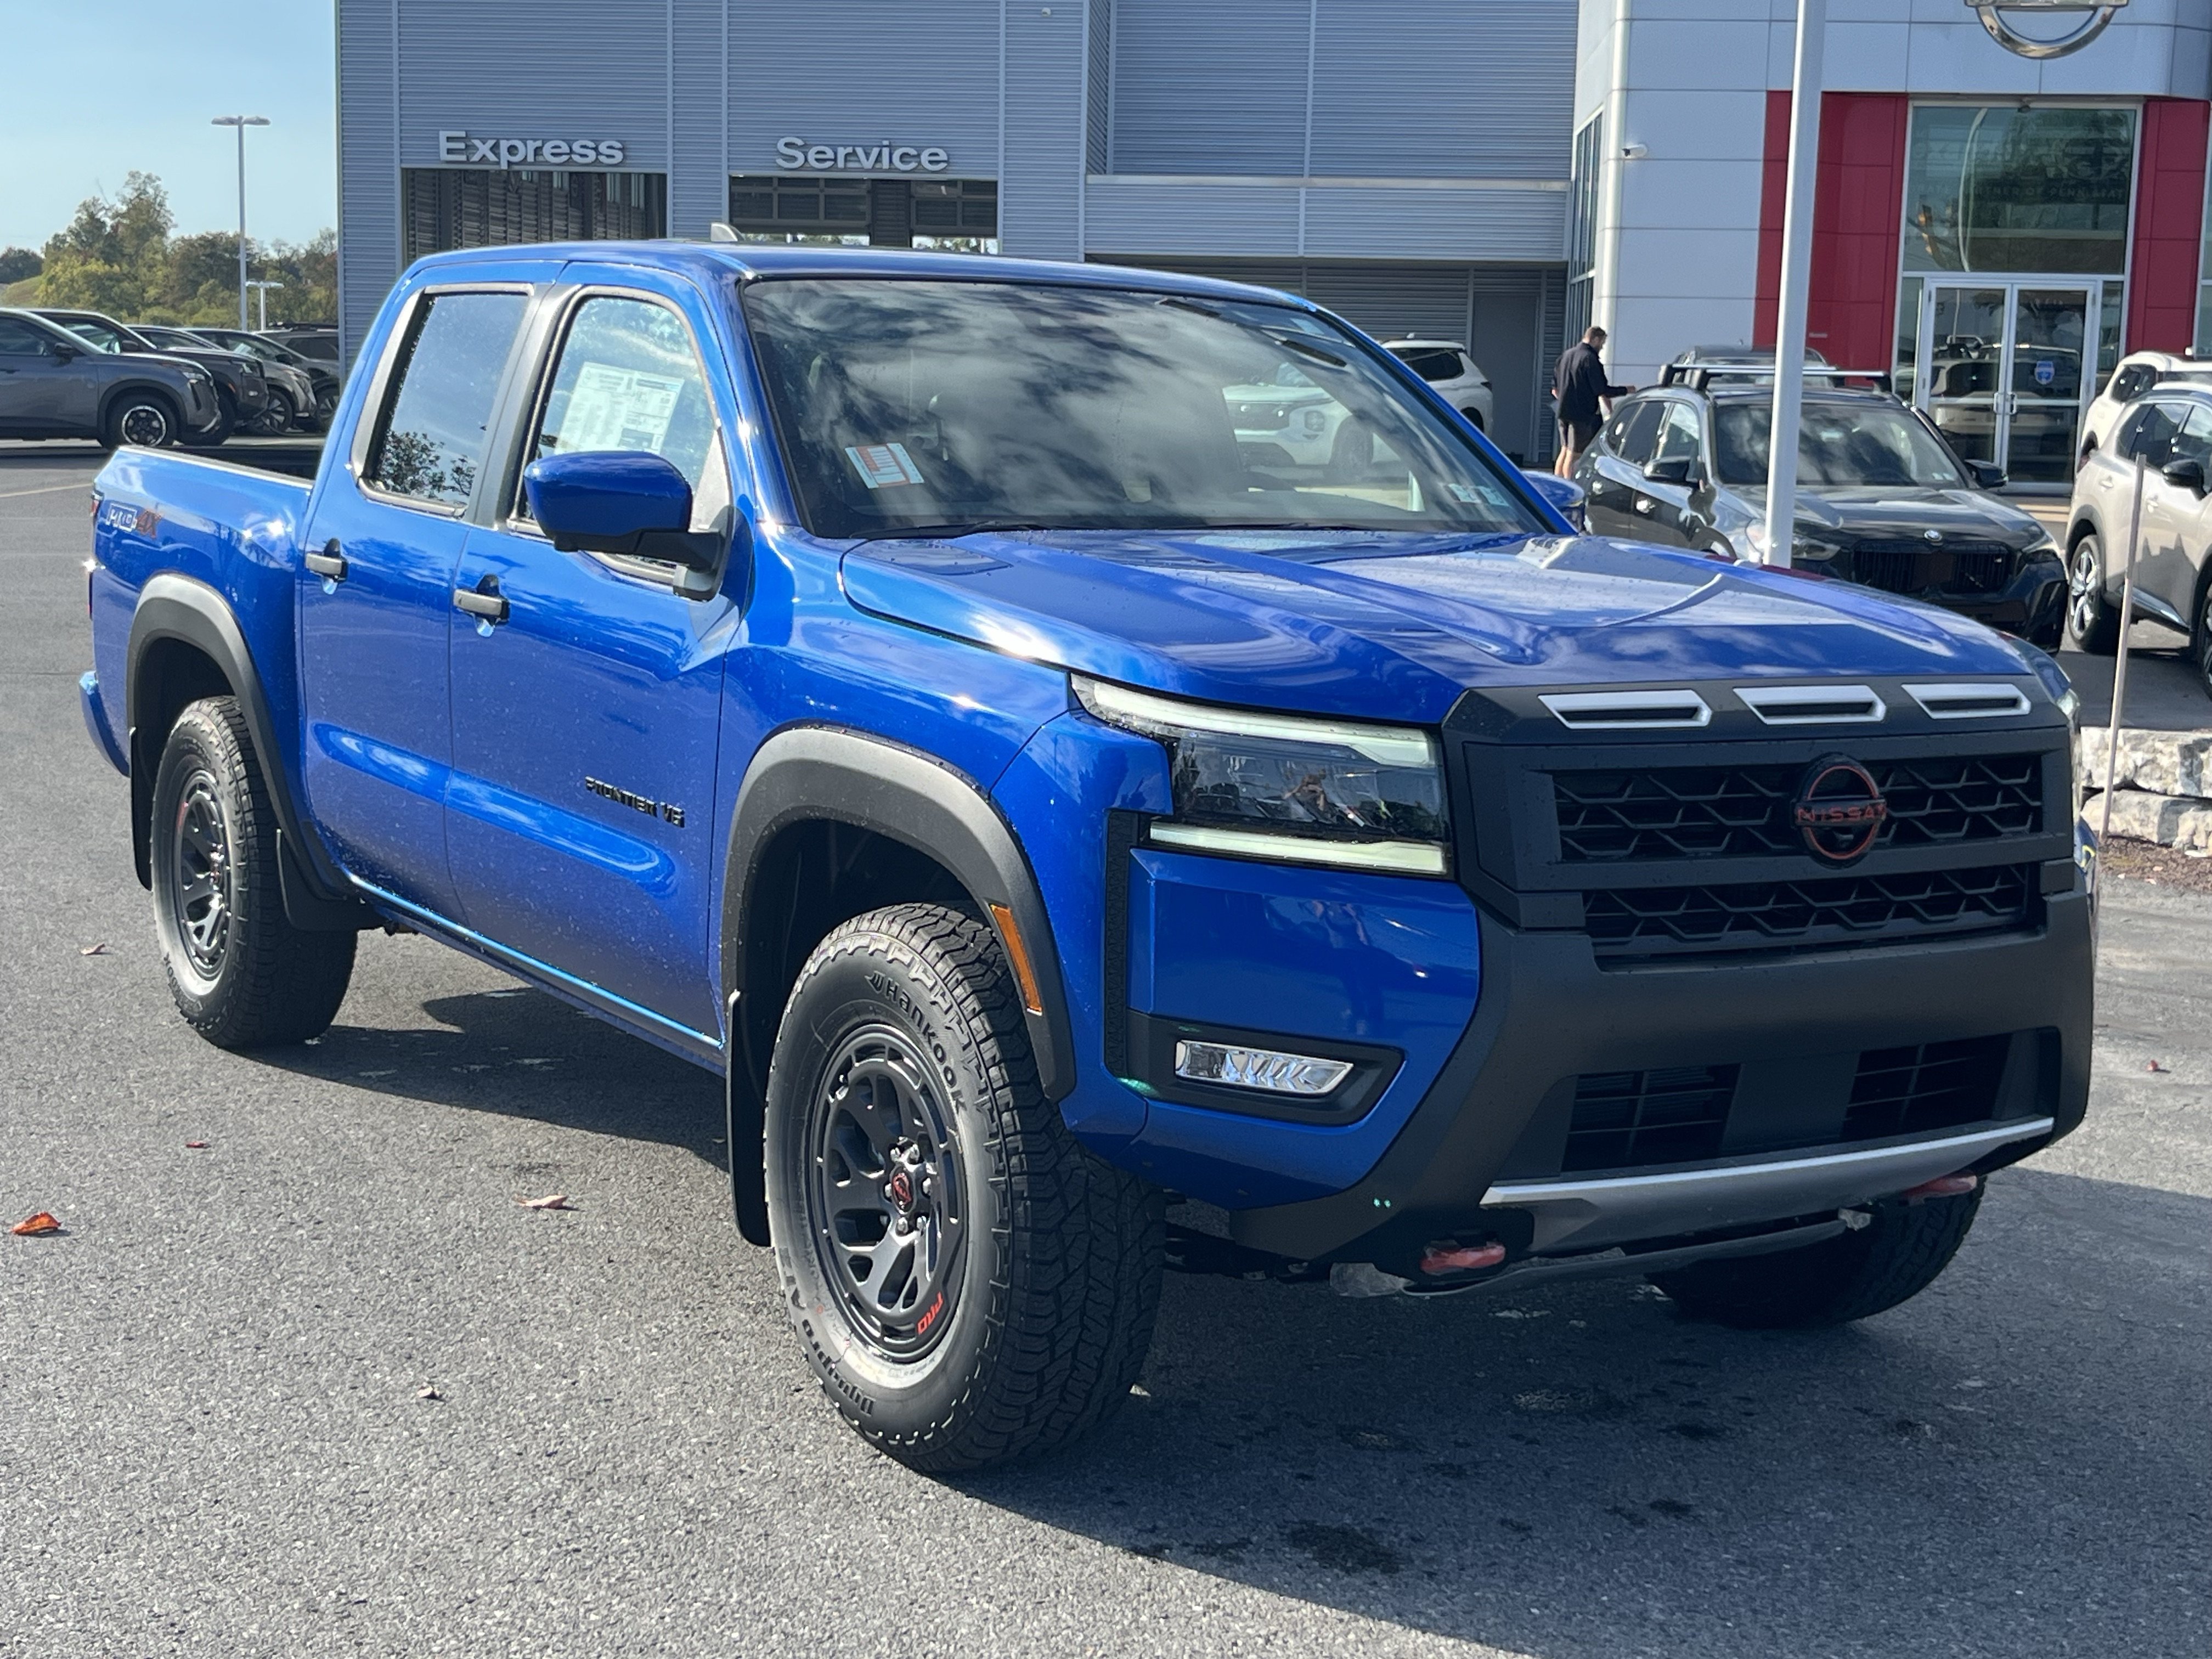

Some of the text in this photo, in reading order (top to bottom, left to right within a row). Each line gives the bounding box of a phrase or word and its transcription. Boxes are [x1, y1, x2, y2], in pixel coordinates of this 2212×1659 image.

[438, 130, 625, 170] Express
[775, 136, 949, 172] Service
[584, 775, 686, 828] FRONTIER V6
[1797, 804, 1887, 823] NISSAN
